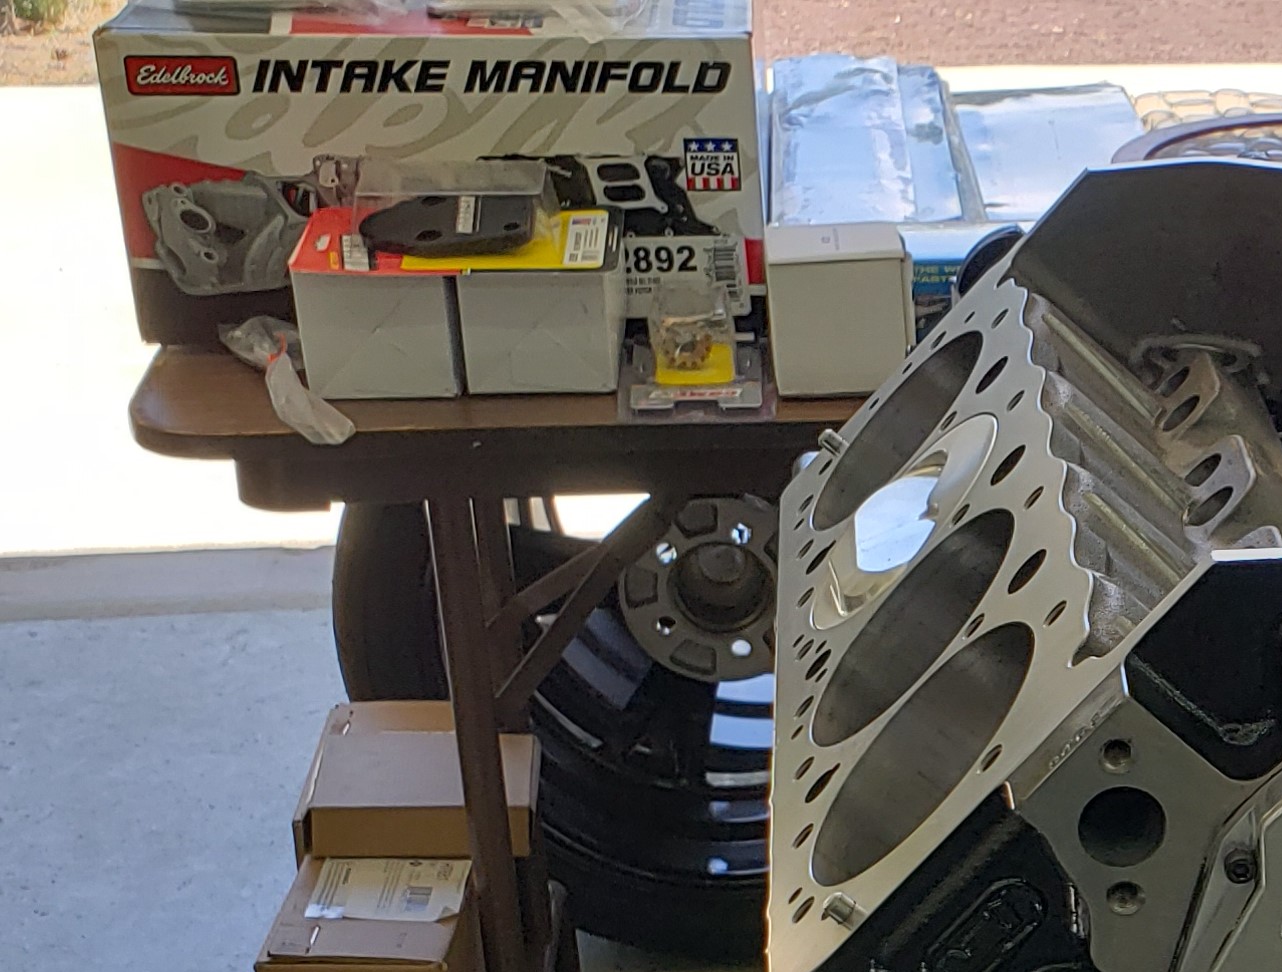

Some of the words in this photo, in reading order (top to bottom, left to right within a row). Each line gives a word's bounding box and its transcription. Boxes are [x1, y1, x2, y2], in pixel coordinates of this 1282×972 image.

[136, 64, 229, 86] Edelbrock
[252, 59, 451, 94] INTAKE
[463, 59, 732, 94] MANIFOLD
[691, 162, 735, 176] USA
[723, 154, 735, 162] IN
[625, 245, 698, 274] 892
